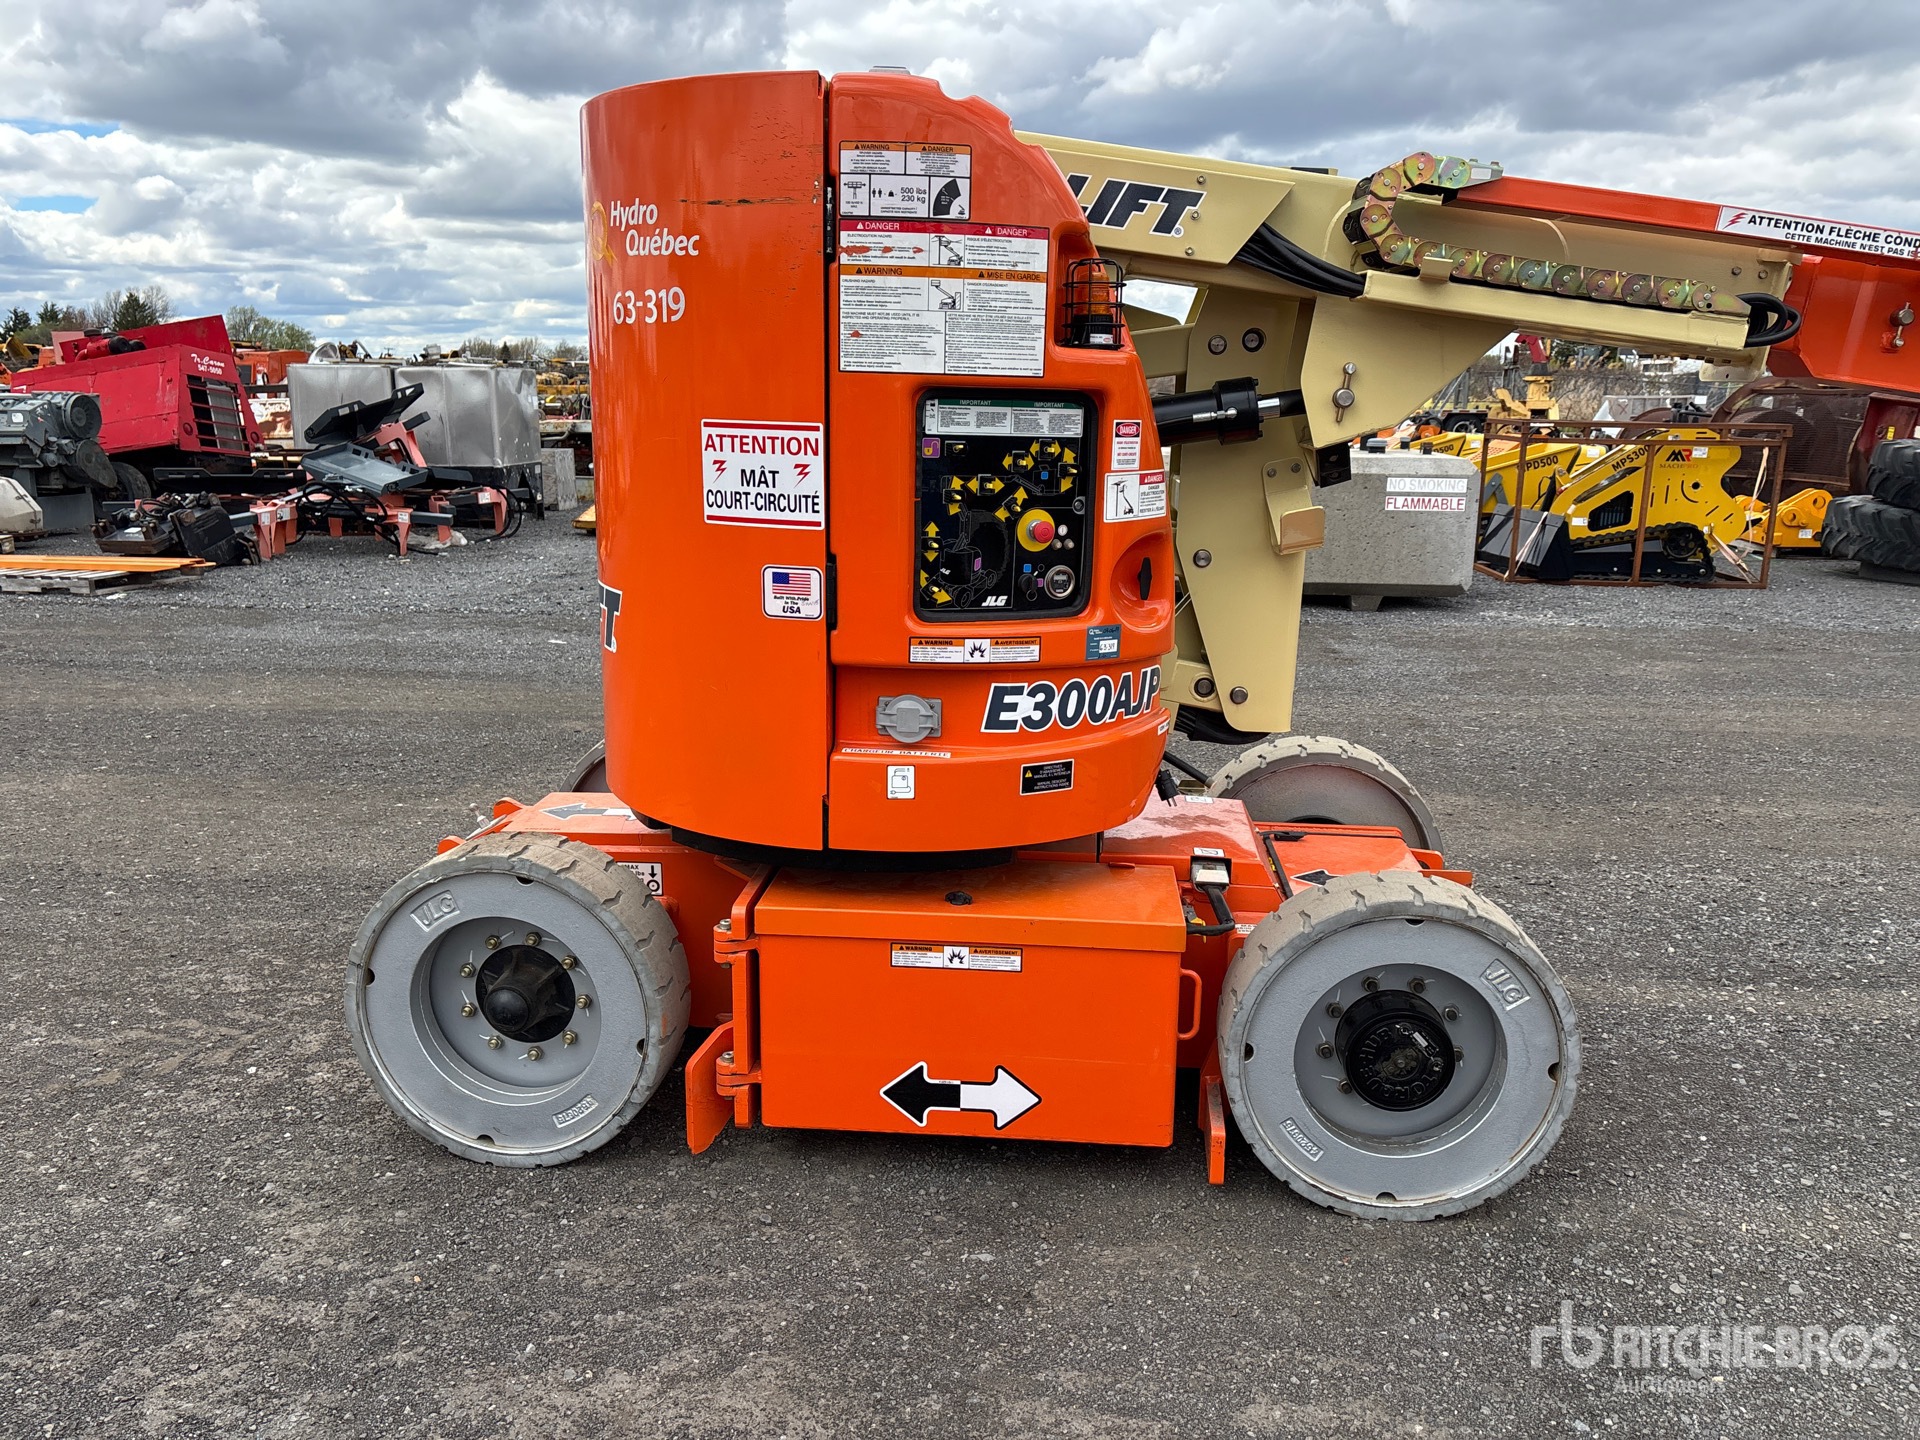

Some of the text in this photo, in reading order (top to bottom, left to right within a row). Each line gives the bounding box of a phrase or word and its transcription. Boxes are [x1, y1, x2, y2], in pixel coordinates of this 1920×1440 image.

[916, 195, 926, 204] kg
[610, 198, 658, 232] Hydro
[865, 222, 900, 230] DANGER
[997, 228, 1028, 236] DANGER
[1748, 214, 1825, 235] ATTENTION
[1829, 226, 1881, 242] FLÈCHE
[626, 228, 700, 256] Québec
[1785, 232, 1812, 242] CETTE
[1814, 236, 1856, 249] MACHINE
[1860, 244, 1885, 253] N'EST
[1887, 247, 1904, 256] PAS
[613, 287, 686, 324] 63-319
[1120, 426, 1136, 434] DANGER
[704, 434, 819, 456] ATTENTION
[1522, 455, 1559, 472] PD500
[740, 465, 780, 488] MÂT
[1147, 475, 1163, 483] DANGER
[1389, 479, 1466, 491] NO SMOKING
[706, 489, 820, 514] COURT-CIRCUITÉ
[1386, 498, 1465, 510] FLAMMABLE
[782, 605, 801, 614] USA
[981, 596, 1008, 606] JLG
[982, 666, 1160, 732] E300AJP
[422, 894, 456, 926] JLG
[1485, 969, 1524, 1005] JLG
